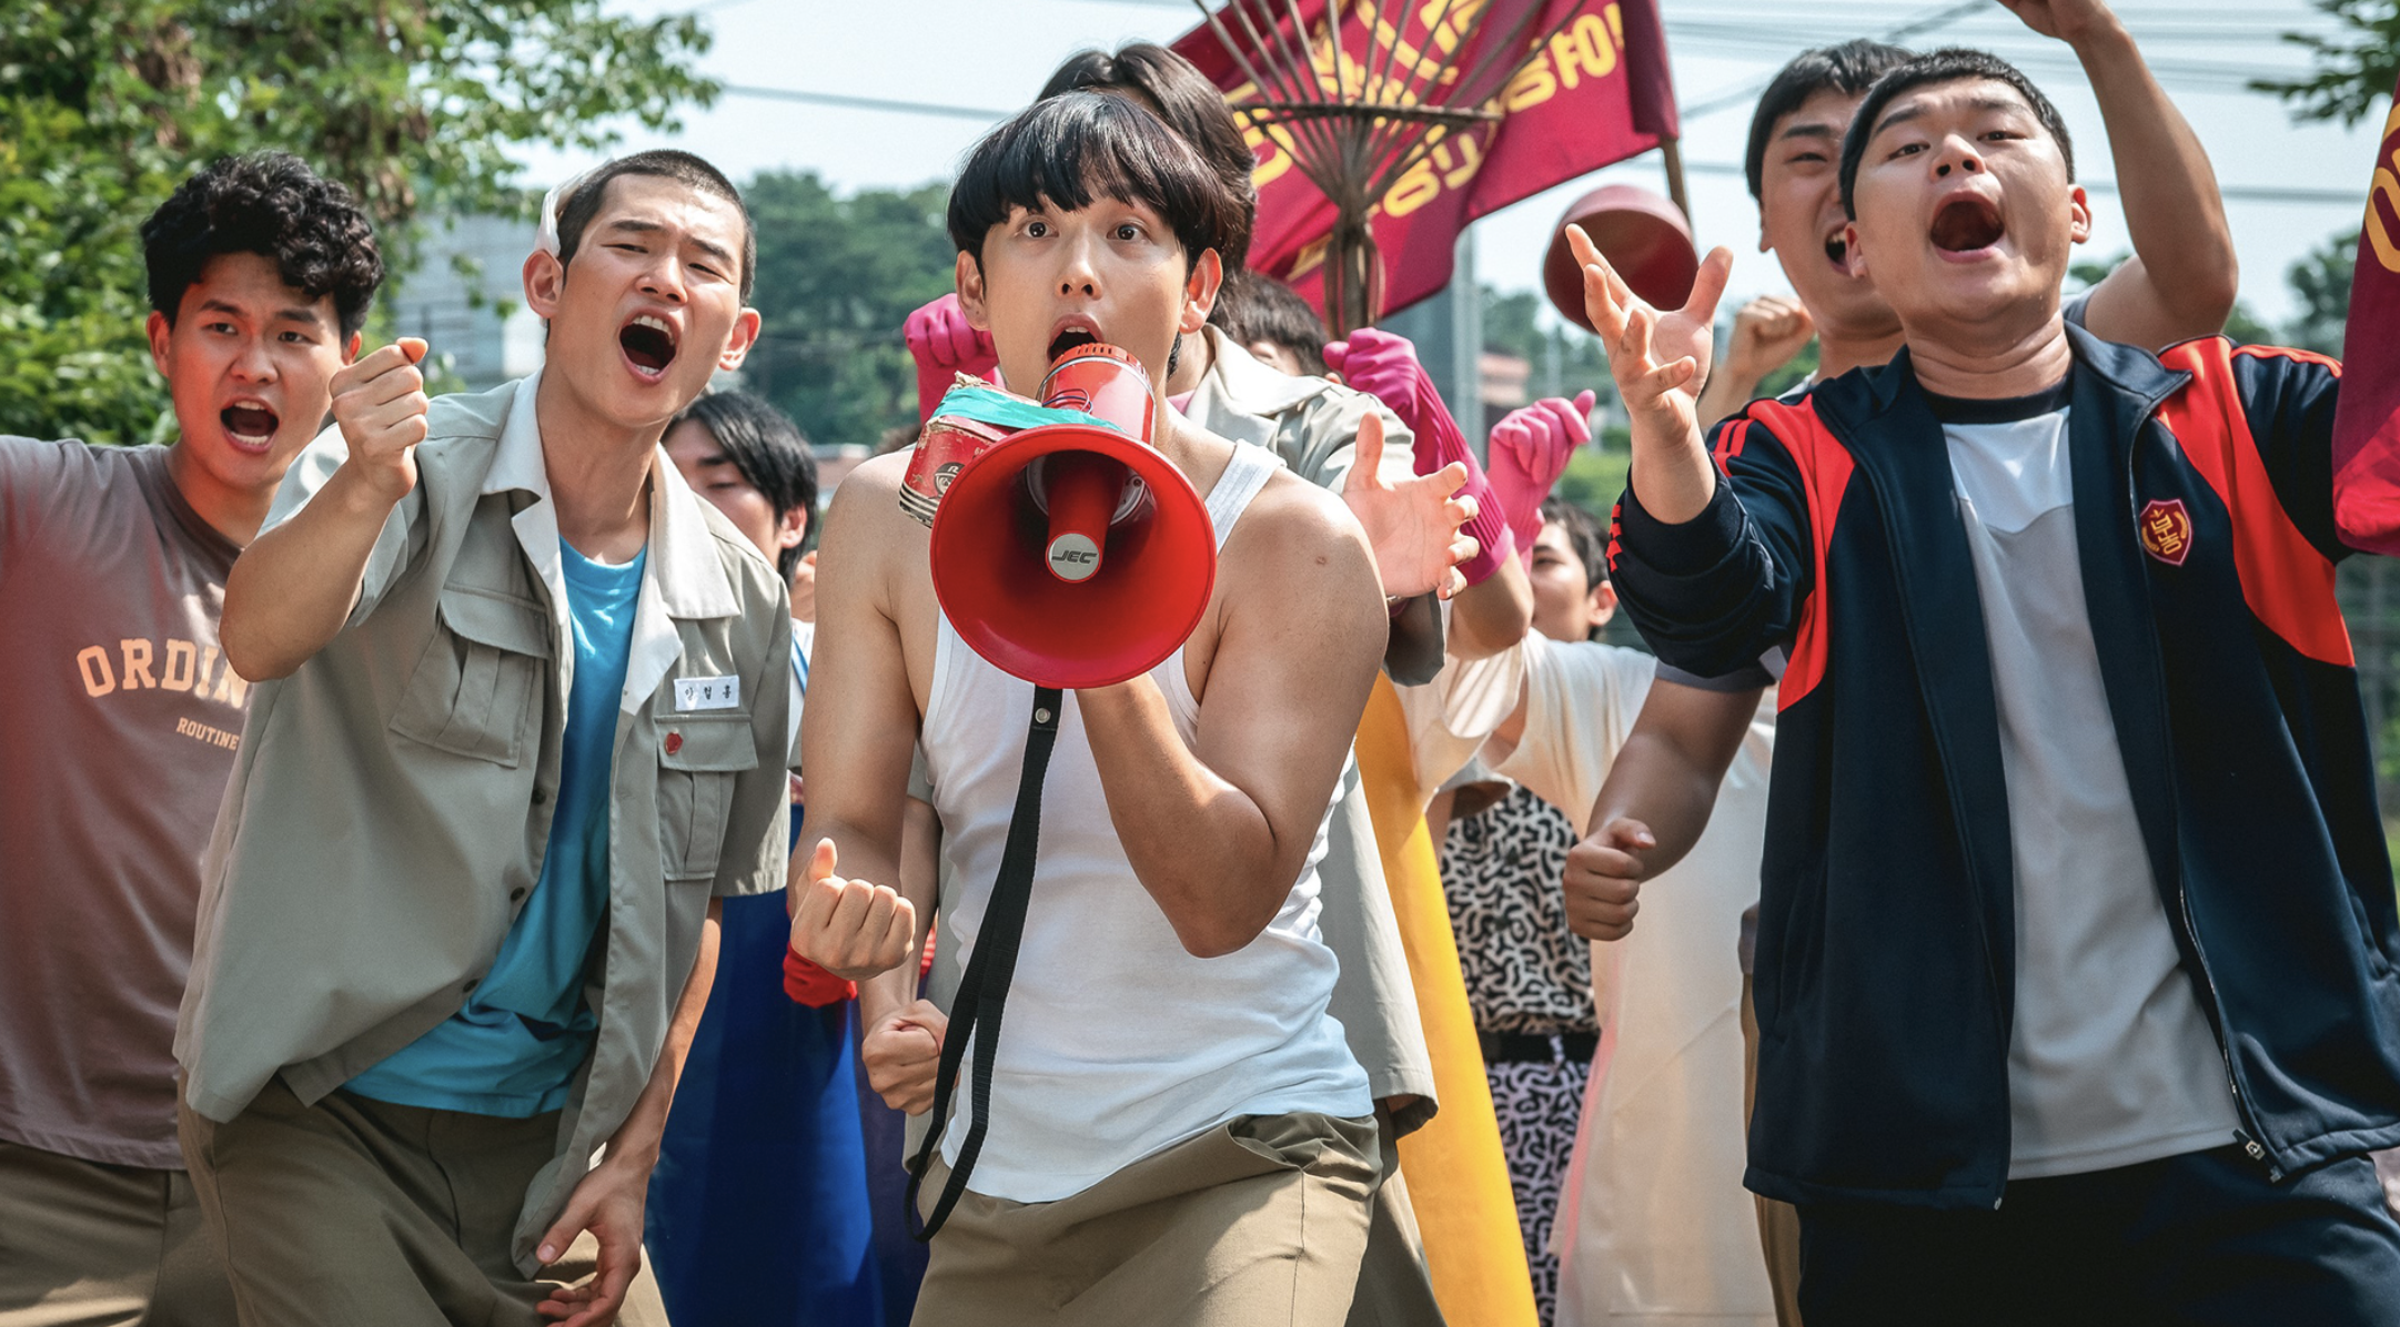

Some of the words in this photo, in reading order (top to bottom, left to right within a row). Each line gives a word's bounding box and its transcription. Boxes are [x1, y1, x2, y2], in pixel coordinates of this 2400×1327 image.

[1051, 550, 1098, 564] JEC
[77, 637, 249, 709] ORDIN
[176, 717, 240, 751] ROUTINE
